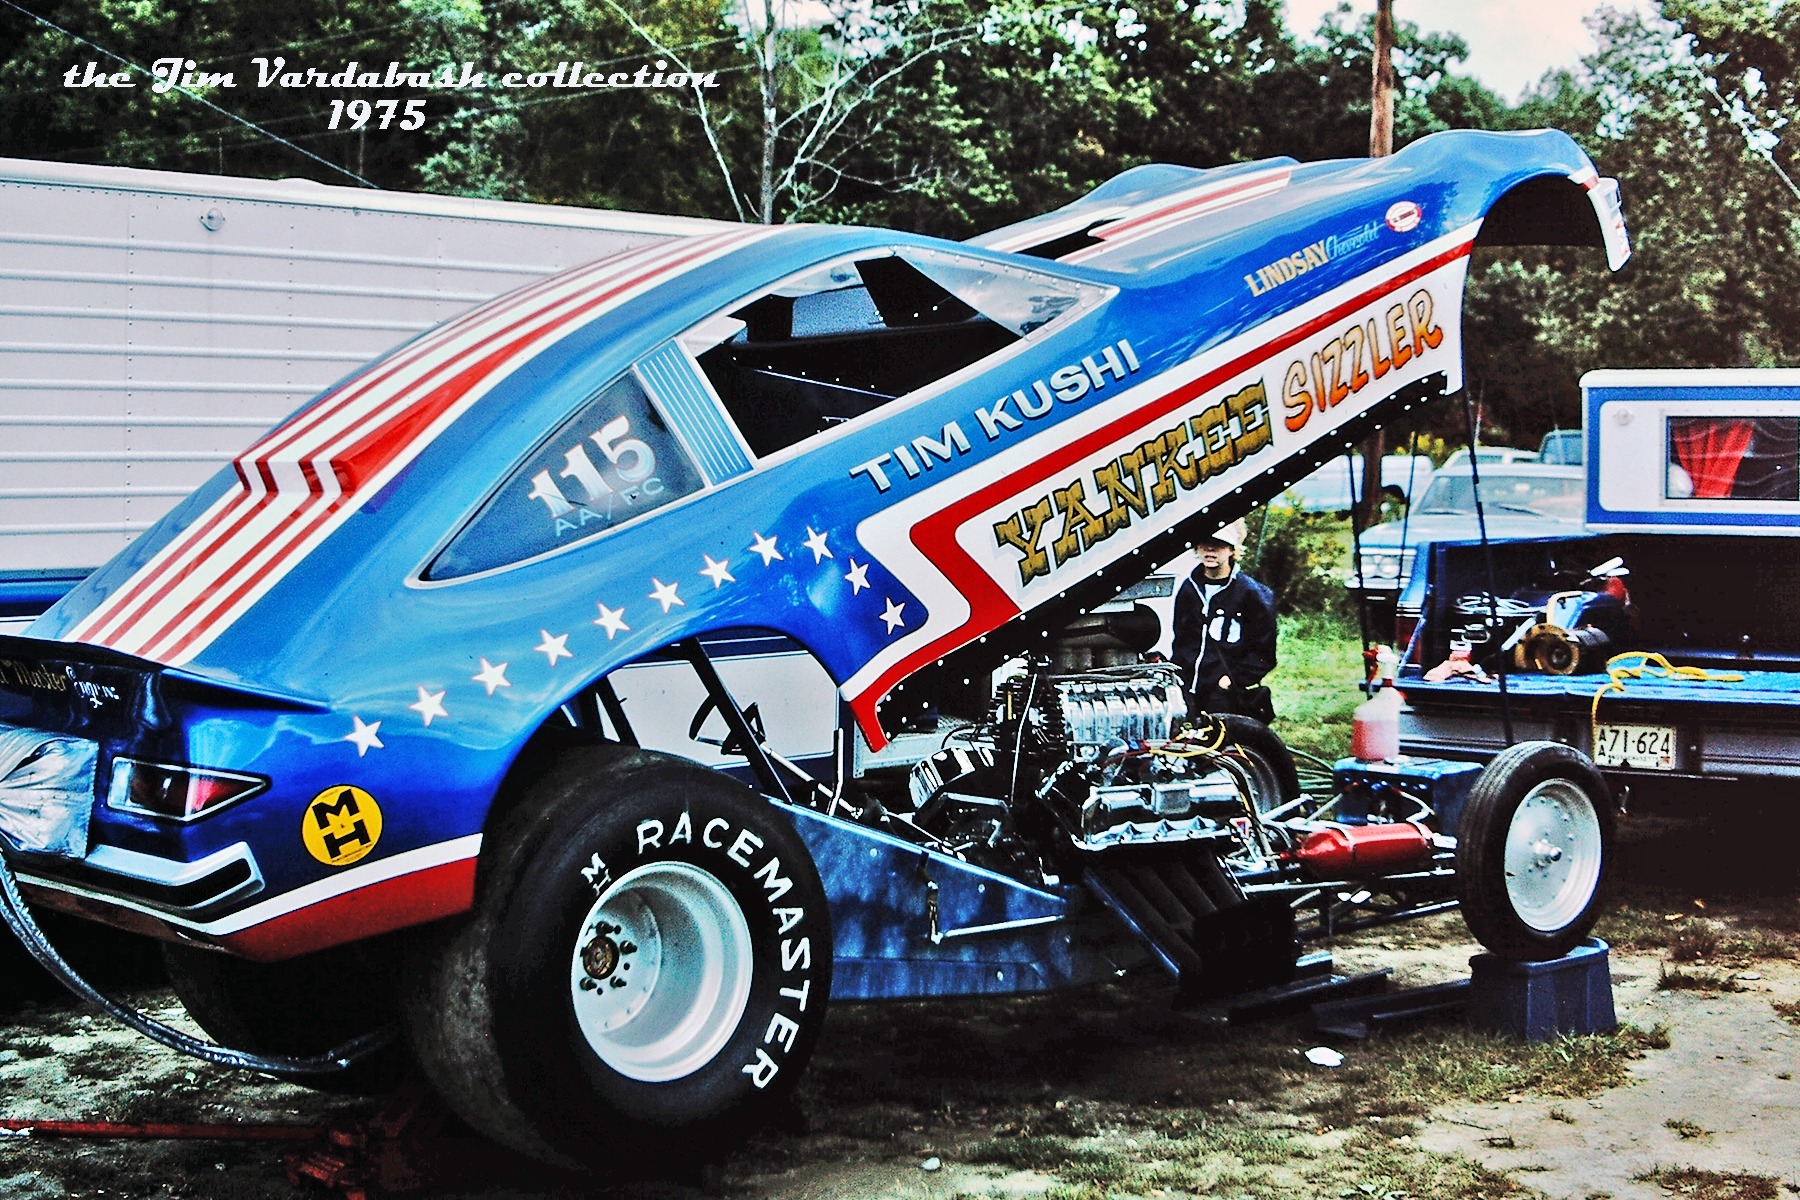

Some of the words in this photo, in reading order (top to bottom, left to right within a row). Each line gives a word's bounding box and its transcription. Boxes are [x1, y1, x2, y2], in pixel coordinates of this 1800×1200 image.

[1244, 240, 1329, 297] LINDSAY
[528, 414, 656, 518] 115
[849, 420, 972, 493] TIM
[974, 338, 1141, 440] KUSHI
[993, 376, 1274, 588] YANKEE
[1282, 289, 1444, 433] SIZZLER
[554, 477, 665, 537] AA/FC
[636, 810, 811, 1090] RACEMASTER
